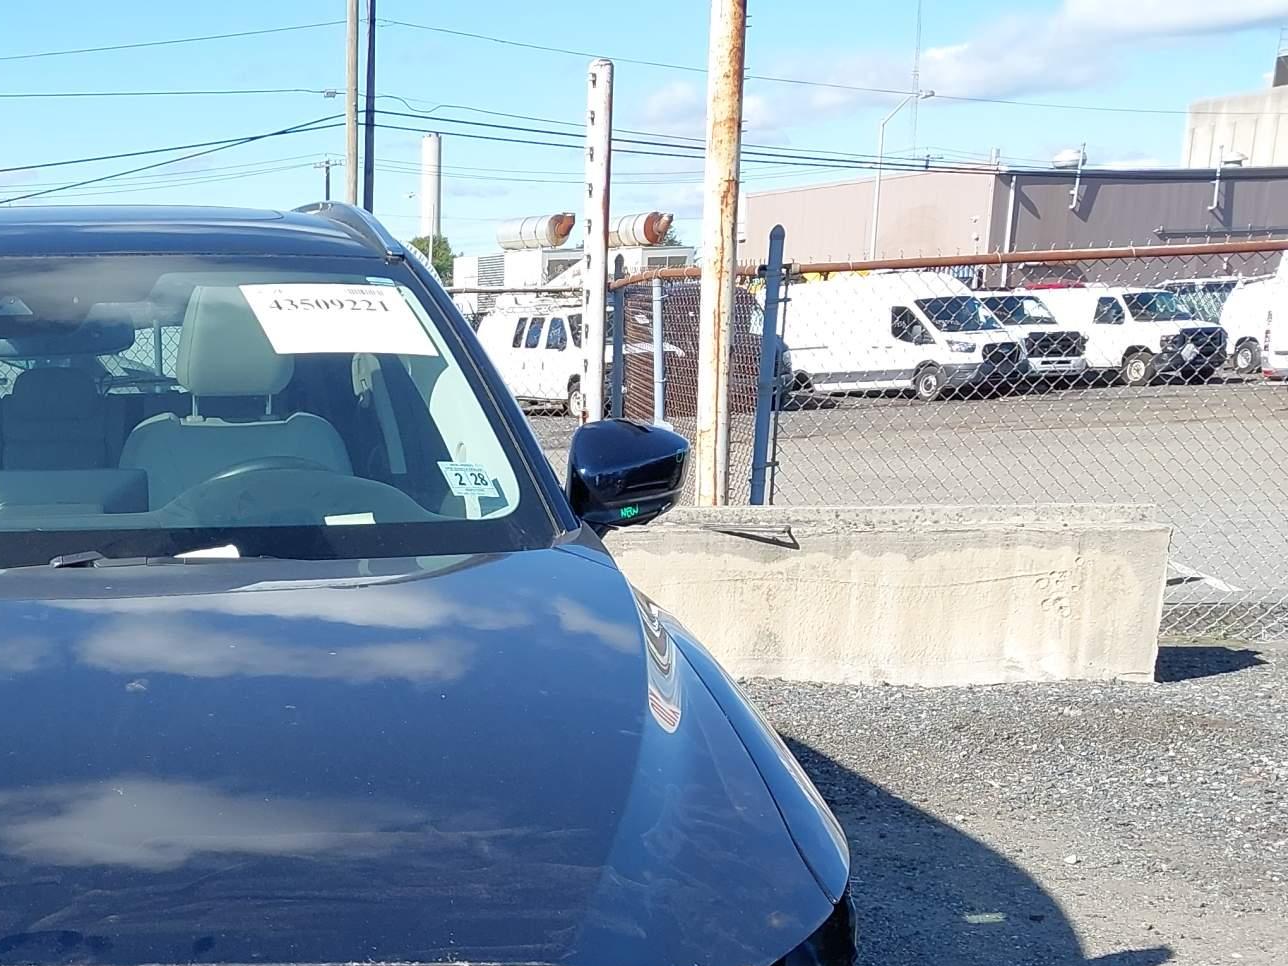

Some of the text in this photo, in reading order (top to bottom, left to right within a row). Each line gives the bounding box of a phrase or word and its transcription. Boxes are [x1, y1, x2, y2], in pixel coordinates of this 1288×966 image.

[269, 298, 391, 312] 43509221
[454, 472, 488, 486] 2 28
